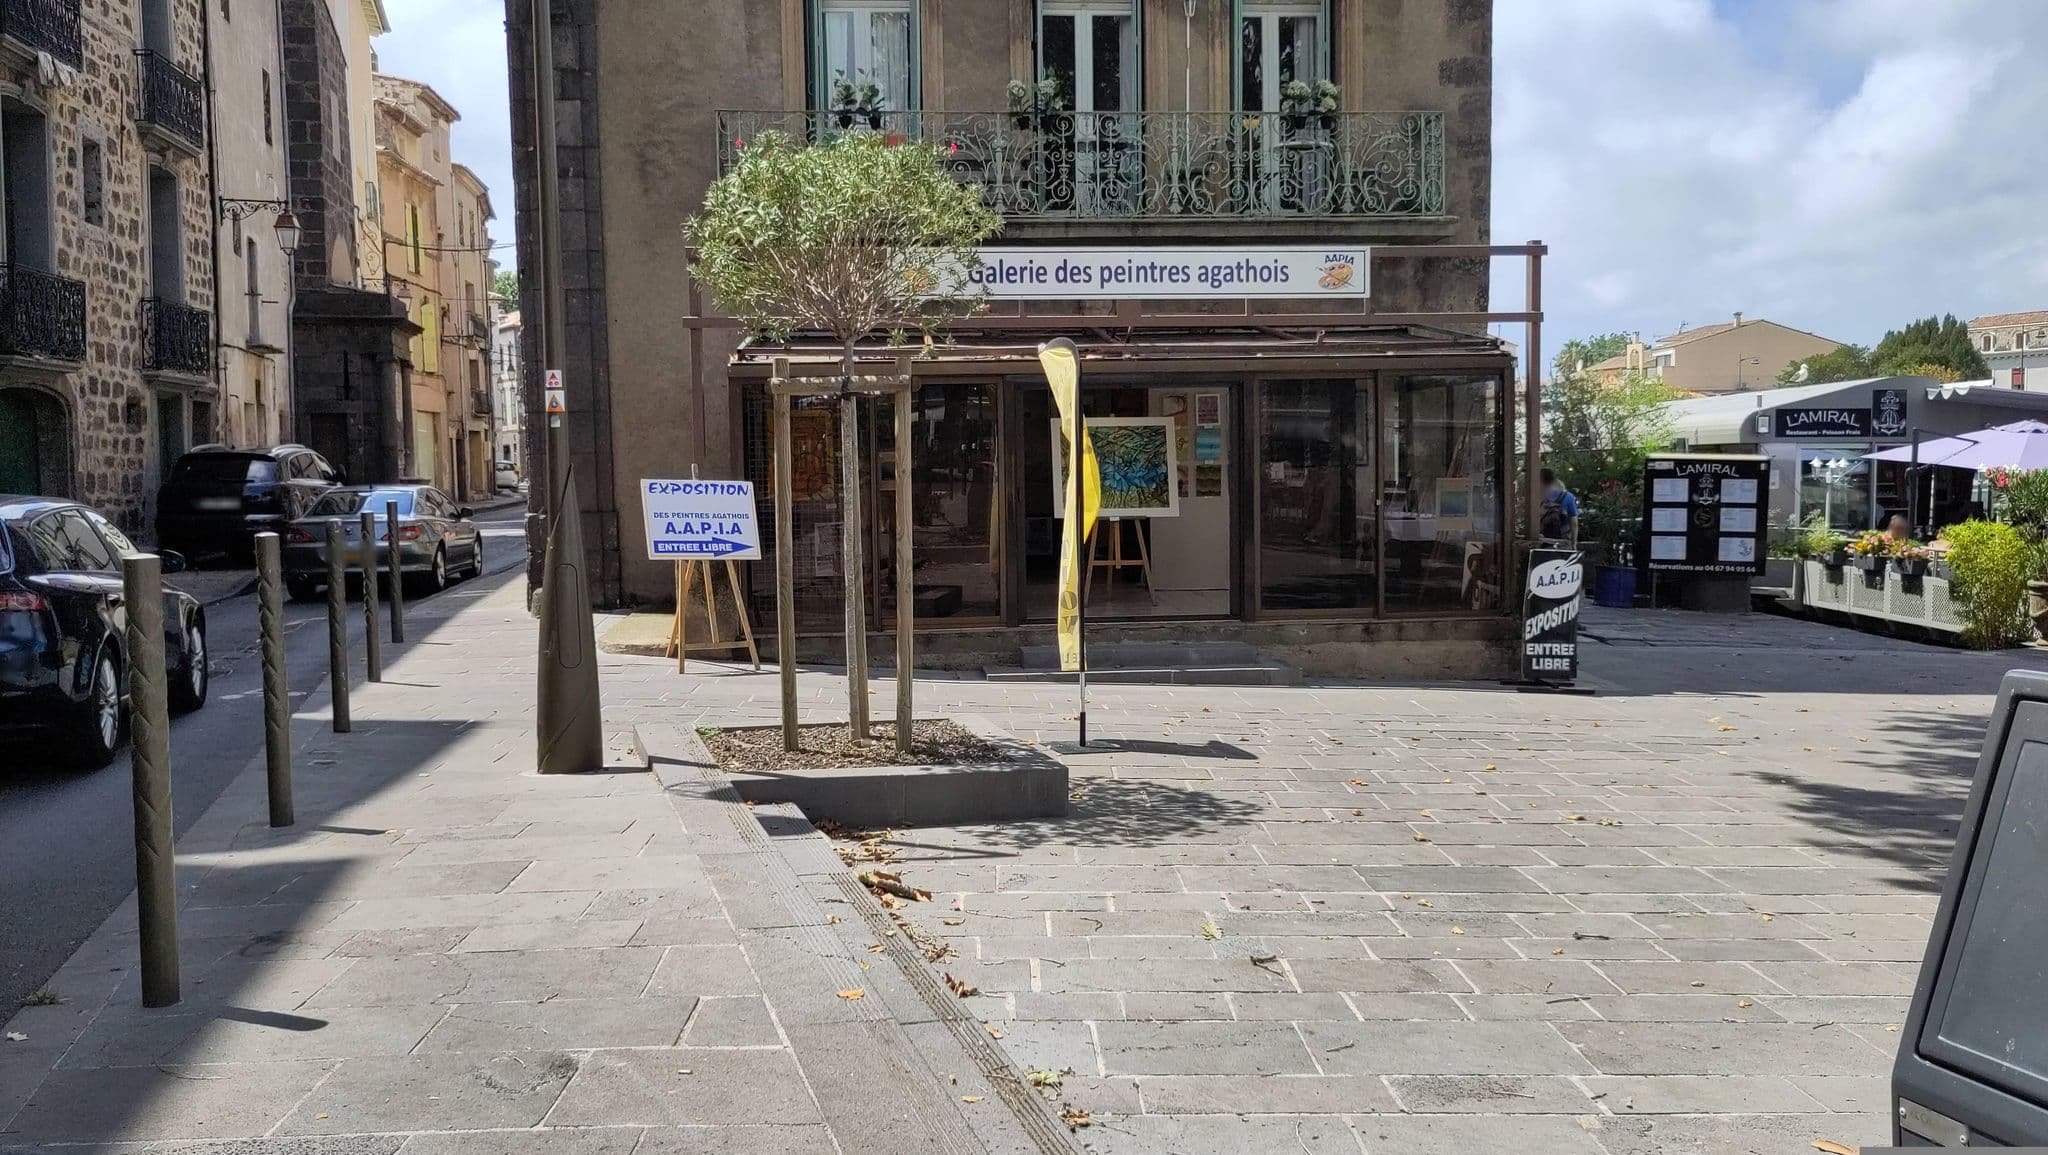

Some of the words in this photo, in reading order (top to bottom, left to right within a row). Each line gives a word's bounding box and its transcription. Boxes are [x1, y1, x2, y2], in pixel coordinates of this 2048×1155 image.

[1324, 254, 1355, 265] AAPIA
[968, 259, 1047, 284] Galerie
[1055, 259, 1092, 284] des
[1100, 259, 1190, 289] peintres
[1198, 258, 1289, 289] agathois
[1786, 410, 1860, 427] L'AMIRAL
[1676, 463, 1739, 477] L'AMIRAL
[648, 482, 749, 496] EXPOSITION
[665, 522, 743, 535] A.A.P.I.A
[658, 543, 700, 551] ENTREE
[703, 543, 733, 551] LIBRE
[1526, 643, 1575, 656] ENTREE
[1532, 658, 1571, 670] LIBRE
